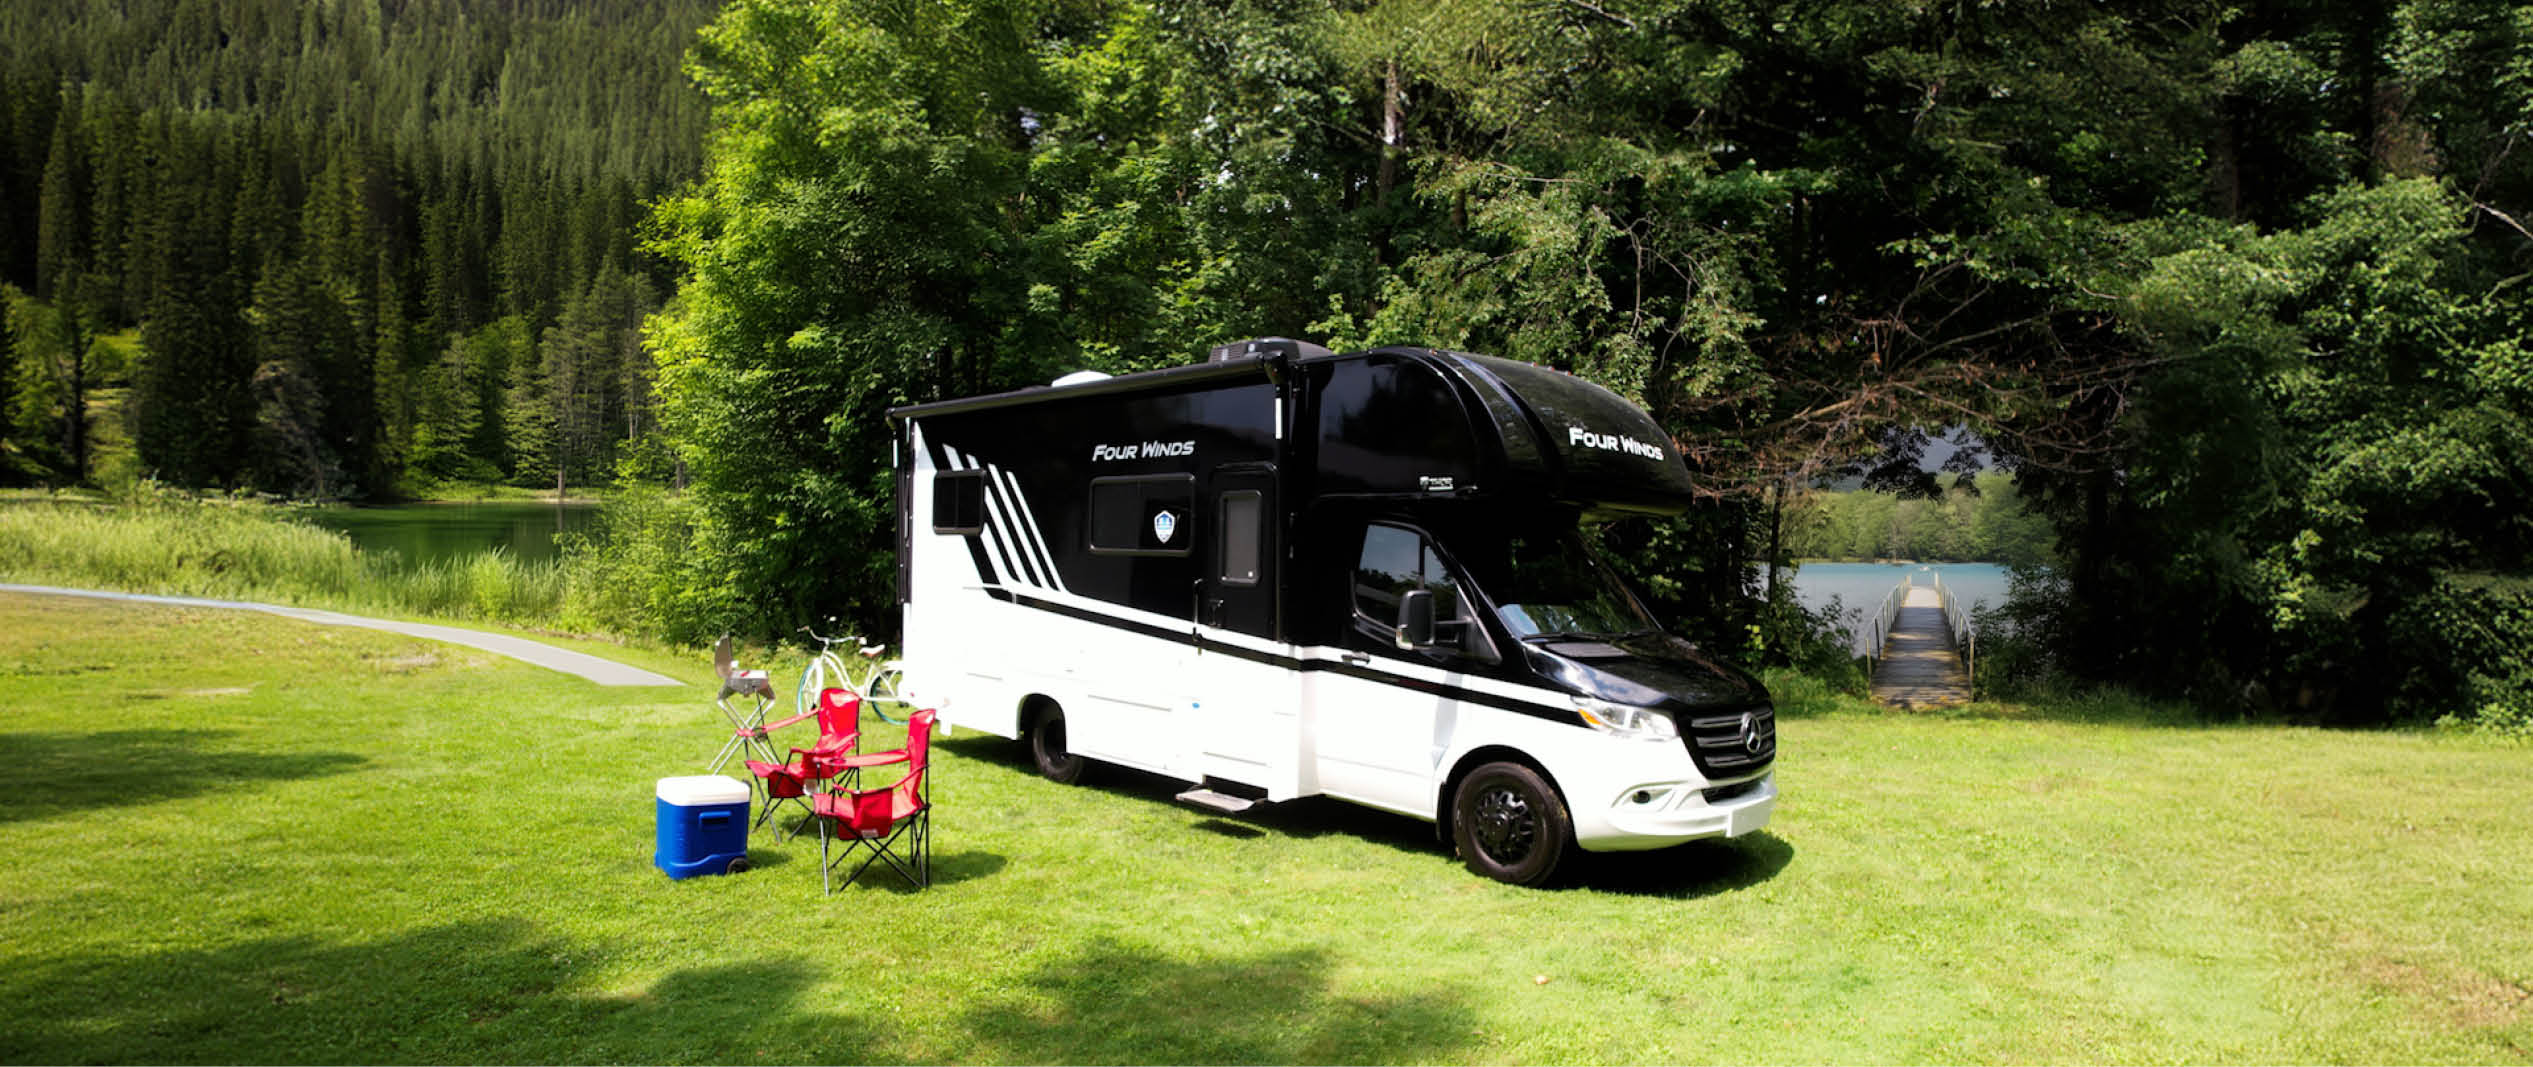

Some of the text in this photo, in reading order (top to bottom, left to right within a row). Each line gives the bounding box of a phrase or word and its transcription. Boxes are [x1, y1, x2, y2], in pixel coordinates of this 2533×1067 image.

[1092, 440, 1195, 461] FOUR WINDS
[1569, 427, 1664, 461] FOUR WINDS
